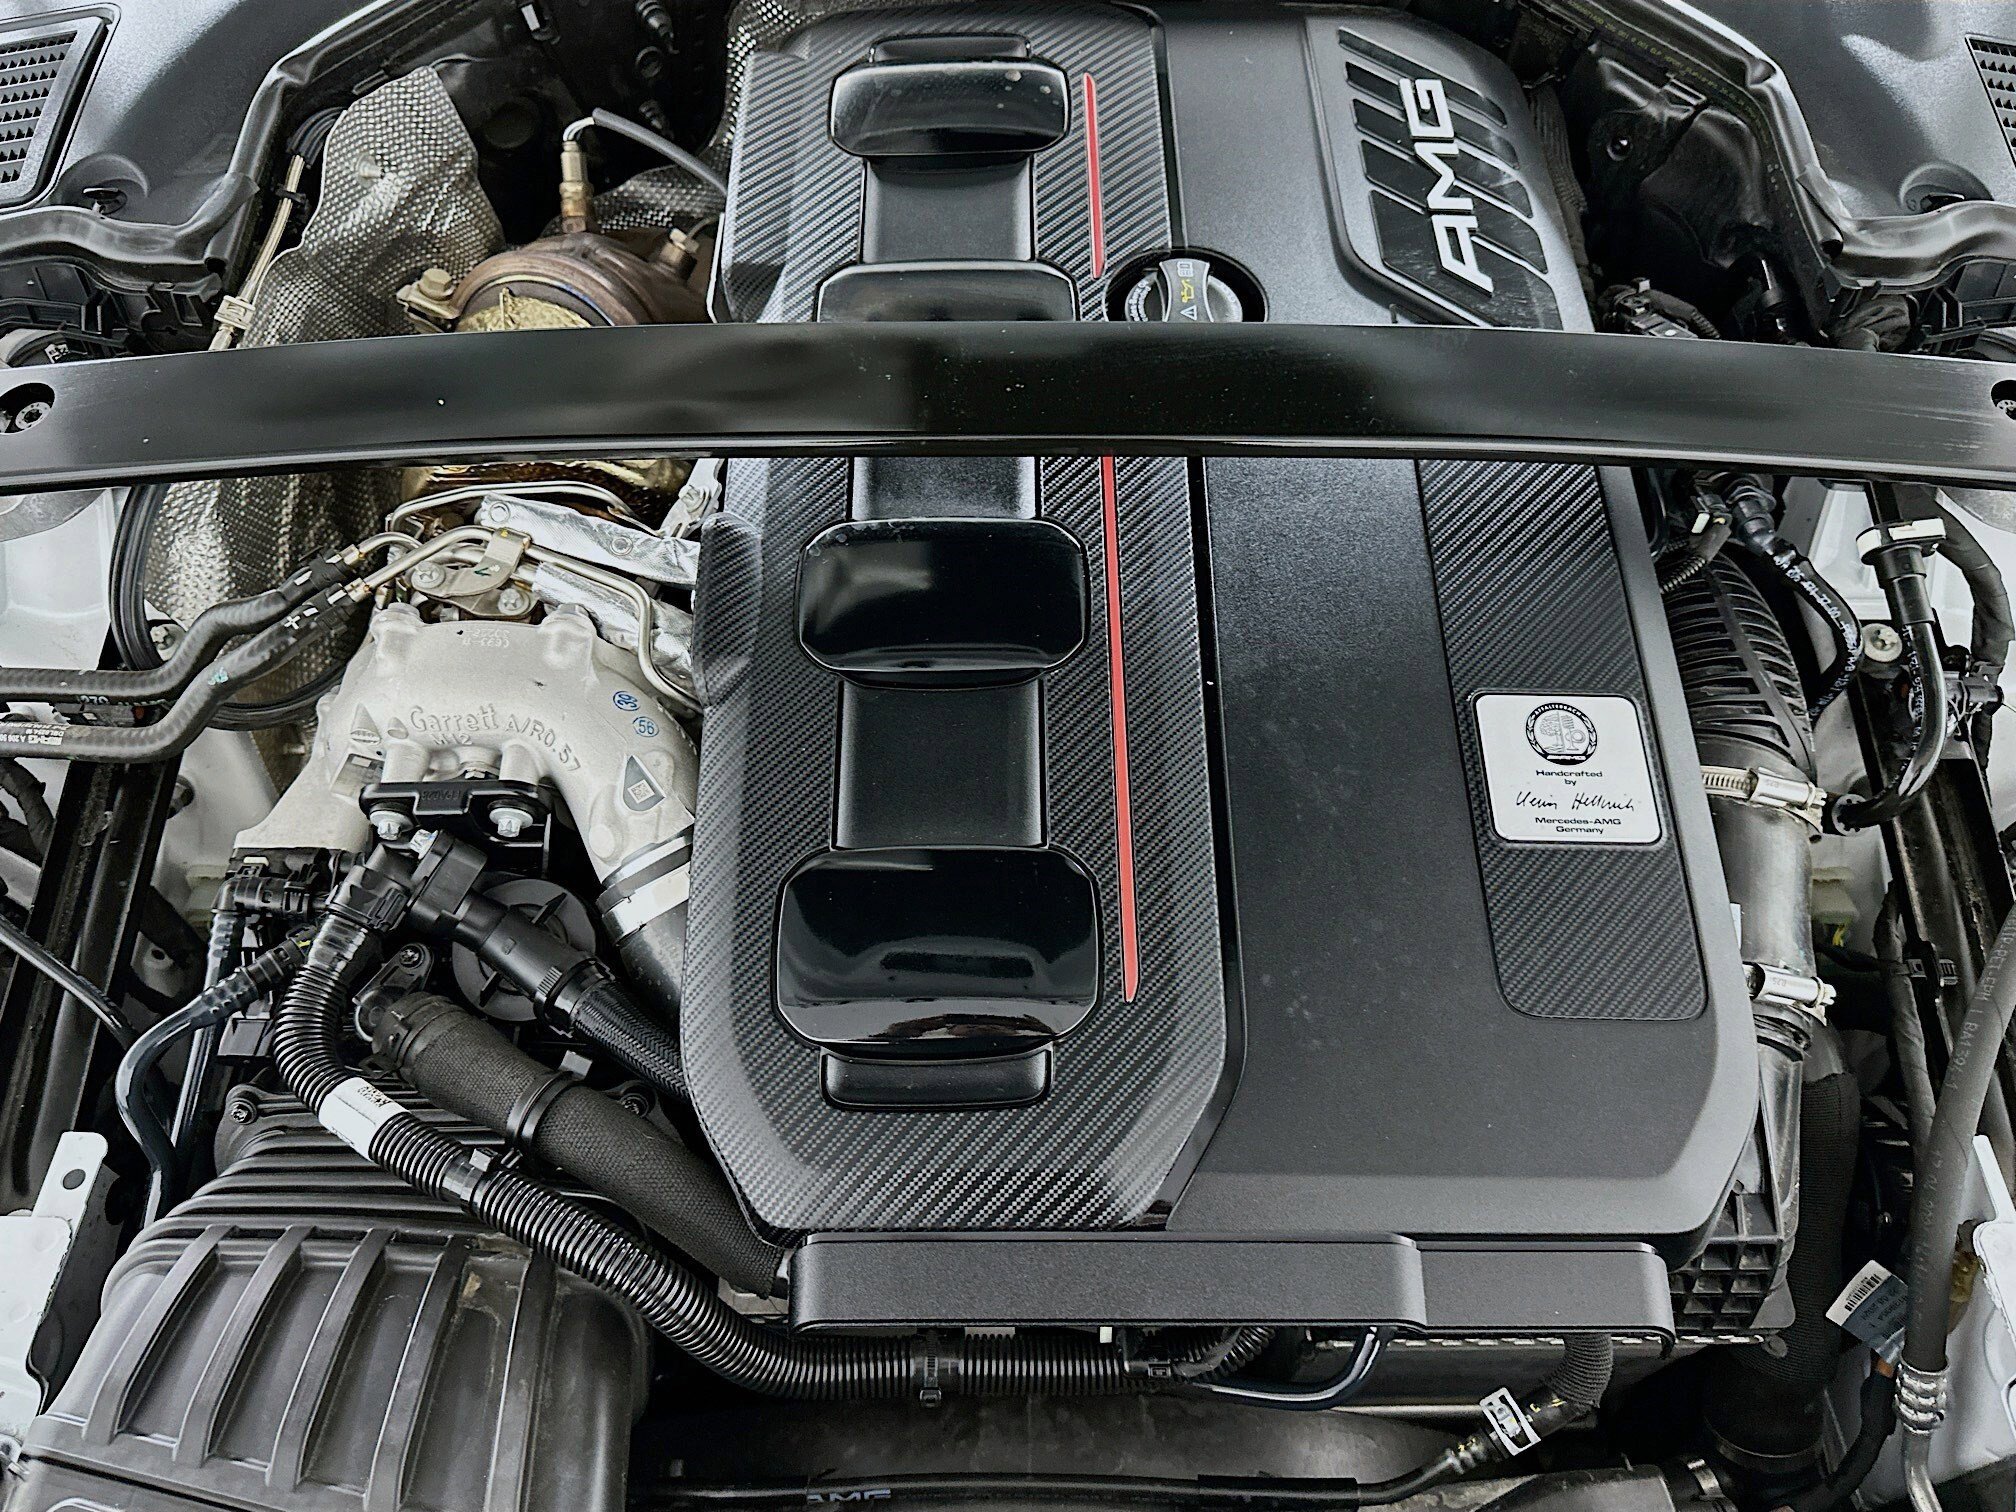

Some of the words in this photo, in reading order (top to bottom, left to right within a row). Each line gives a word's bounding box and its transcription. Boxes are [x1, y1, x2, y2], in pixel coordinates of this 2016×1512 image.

[1399, 78, 1494, 297] AMG
[410, 705, 499, 731] Garrett
[638, 719, 655, 735] 56
[1535, 817, 1622, 825] Mercedes-AMG
[1555, 826, 1604, 834] Germany
